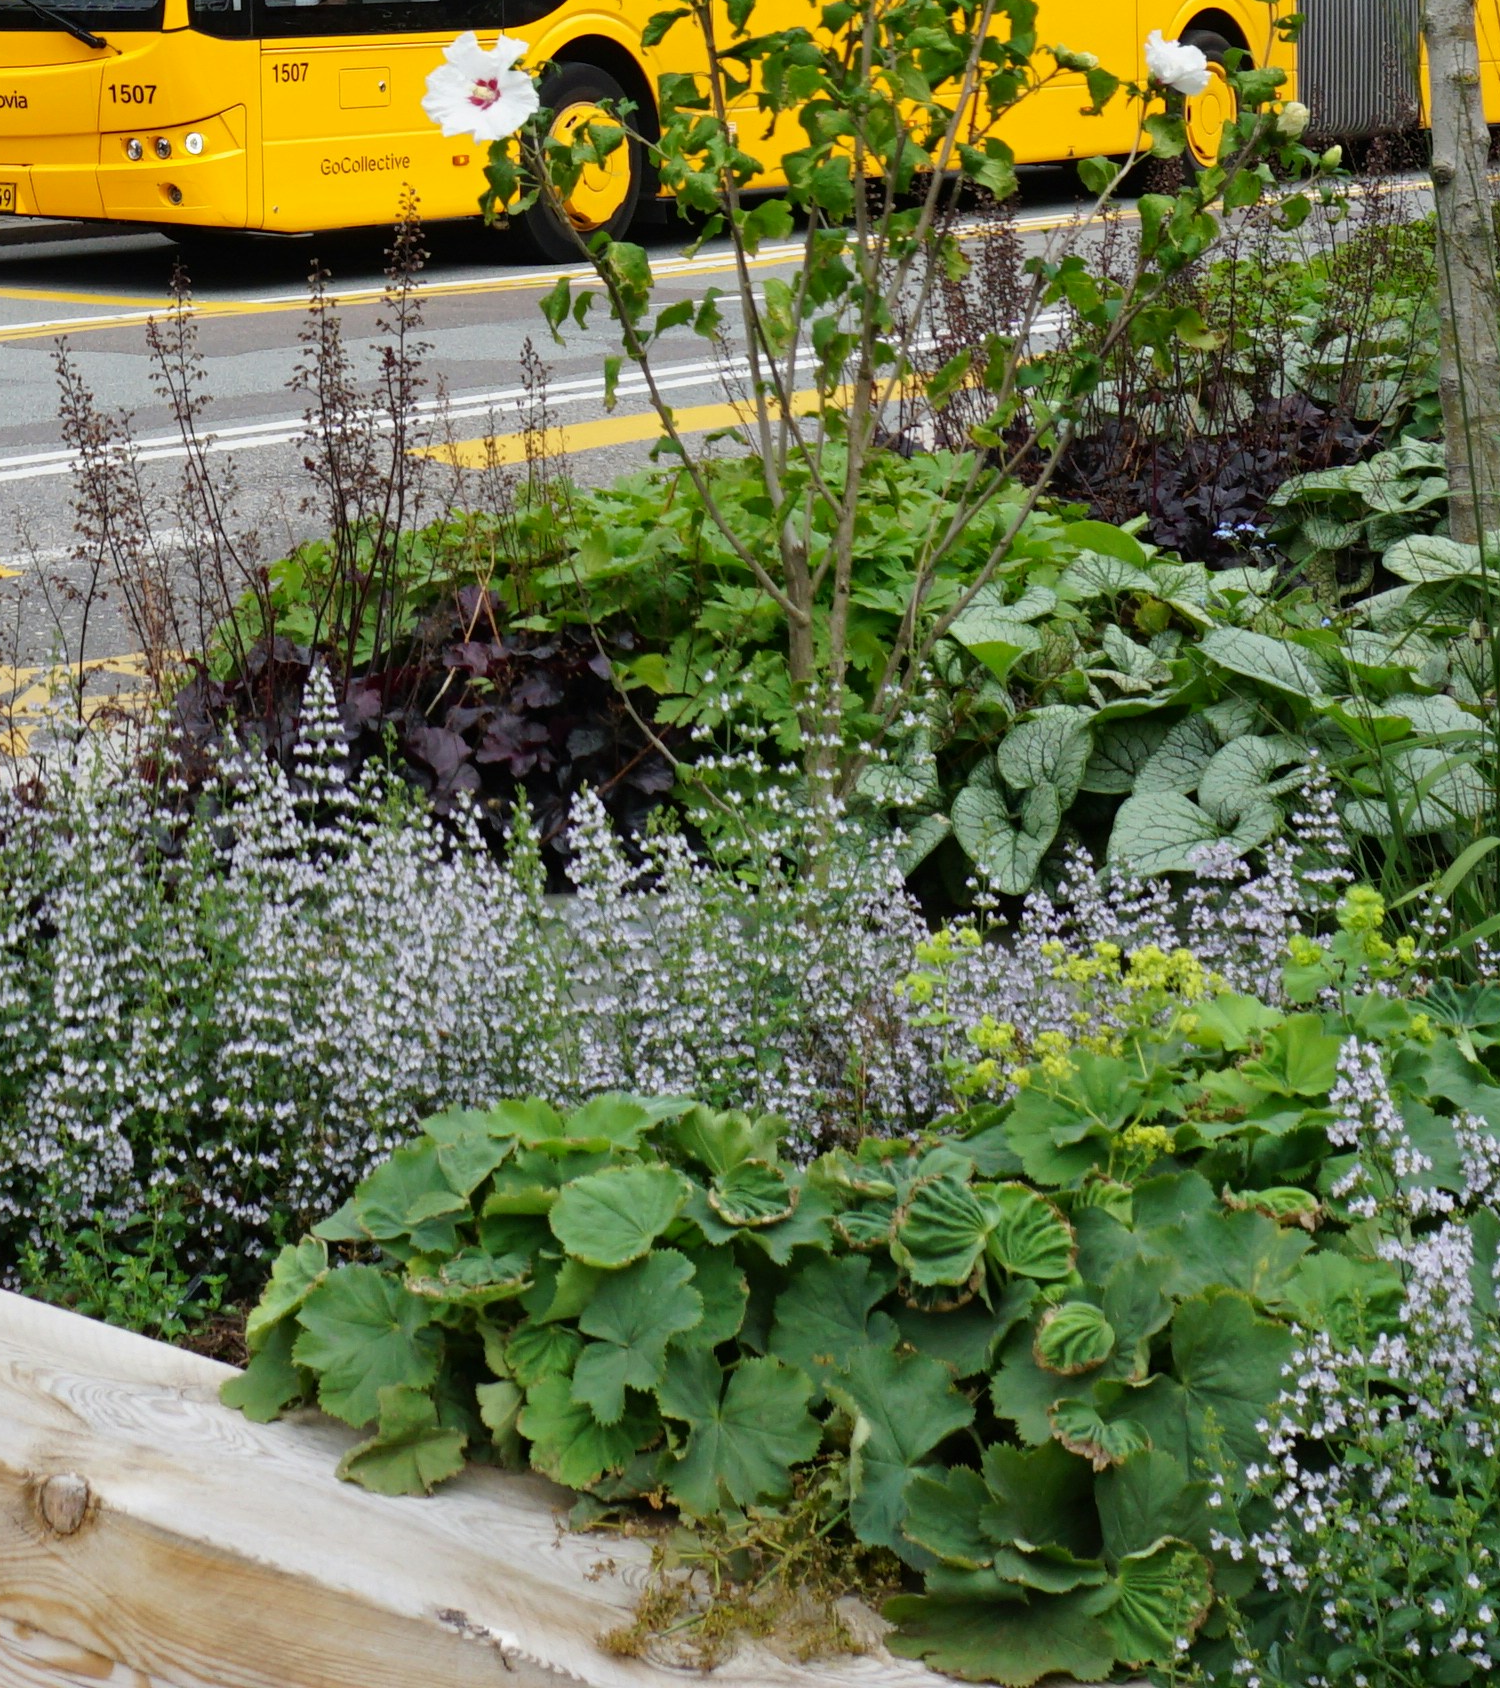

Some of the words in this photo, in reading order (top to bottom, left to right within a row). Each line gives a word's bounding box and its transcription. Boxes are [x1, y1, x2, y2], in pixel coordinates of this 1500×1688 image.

[272, 62, 309, 83] 1507
[108, 84, 157, 105] 1507
[320, 153, 410, 176] GoCollective
